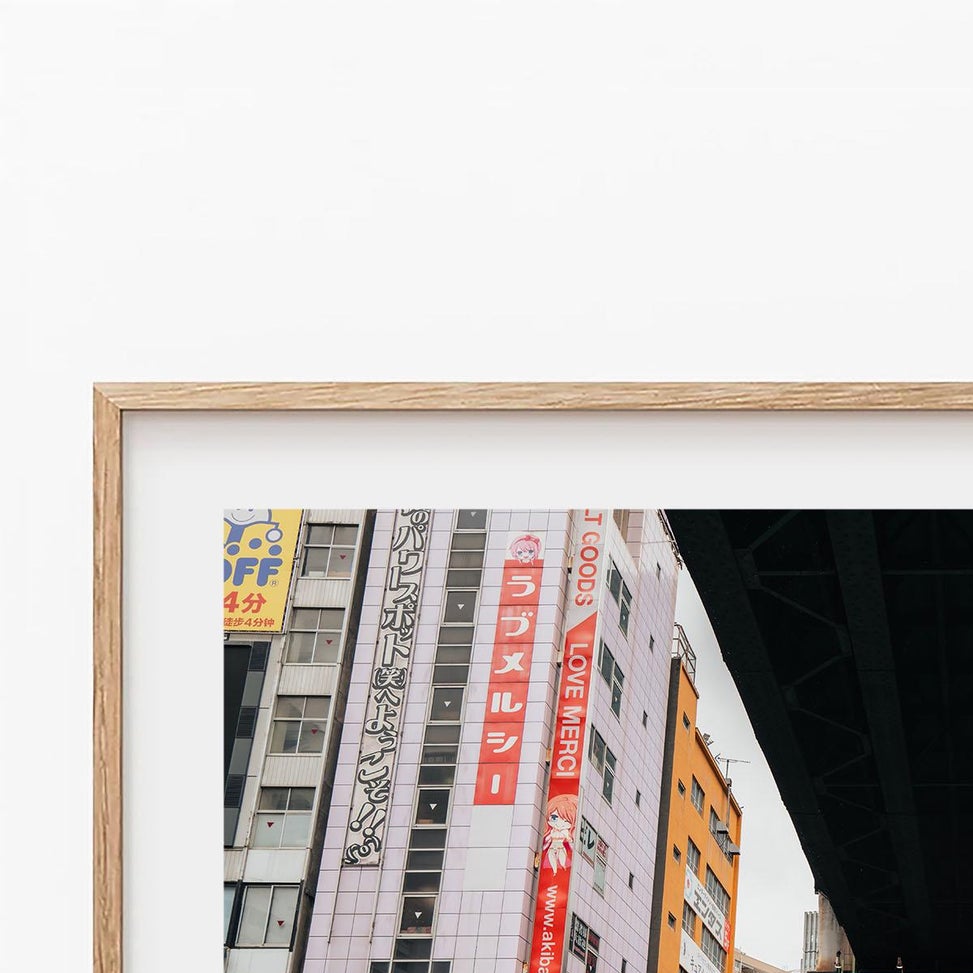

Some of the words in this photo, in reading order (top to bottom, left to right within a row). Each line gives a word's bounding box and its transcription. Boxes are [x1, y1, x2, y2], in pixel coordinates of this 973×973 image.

[583, 509, 603, 526] T
[575, 532, 601, 607] GOODS
[350, 509, 430, 835] のパワースポット(笑)へようこそ!!
[486, 575, 535, 795] ラブメルシー
[565, 643, 589, 699] LOVE
[556, 705, 584, 777] MERCI
